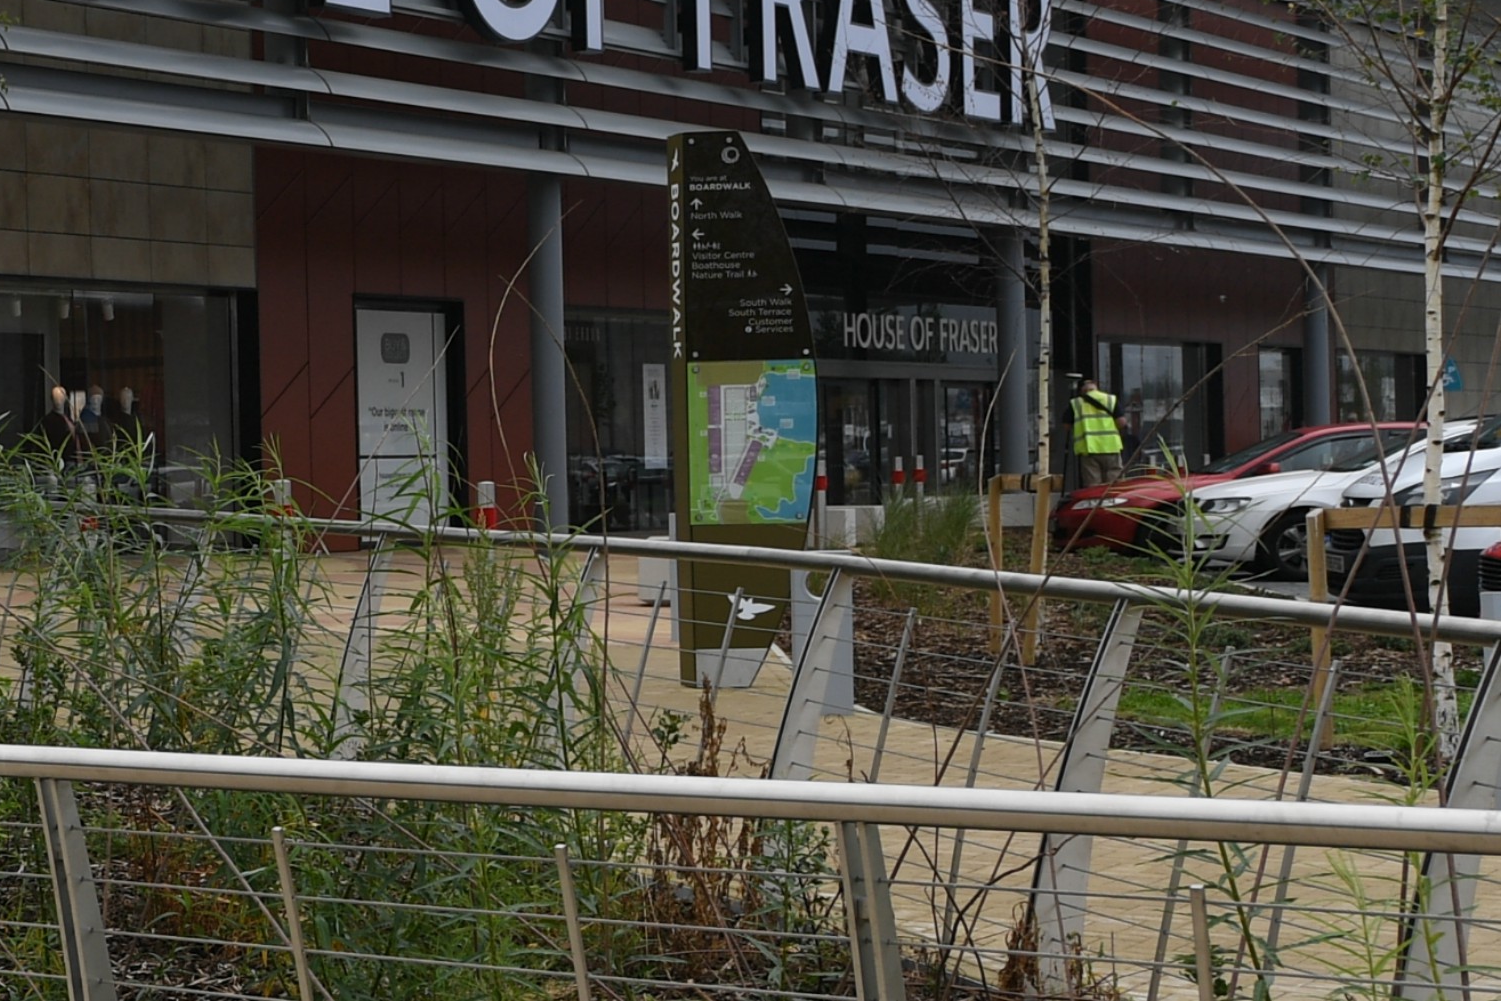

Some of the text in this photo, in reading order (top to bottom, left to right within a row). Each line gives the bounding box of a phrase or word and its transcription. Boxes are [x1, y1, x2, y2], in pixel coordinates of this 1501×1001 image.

[689, 182, 751, 191] BOARDWALK
[690, 210, 742, 220] North Walk
[692, 251, 755, 260] Visitor Centre
[691, 261, 741, 270] Boathouse
[671, 184, 682, 358] BOARDWALK
[691, 270, 744, 279] Nature Trail
[740, 298, 792, 307] South Walk
[728, 308, 792, 317] South Terrace
[748, 318, 793, 326] Customer
[843, 312, 998, 354] HOUSE OF FRASER
